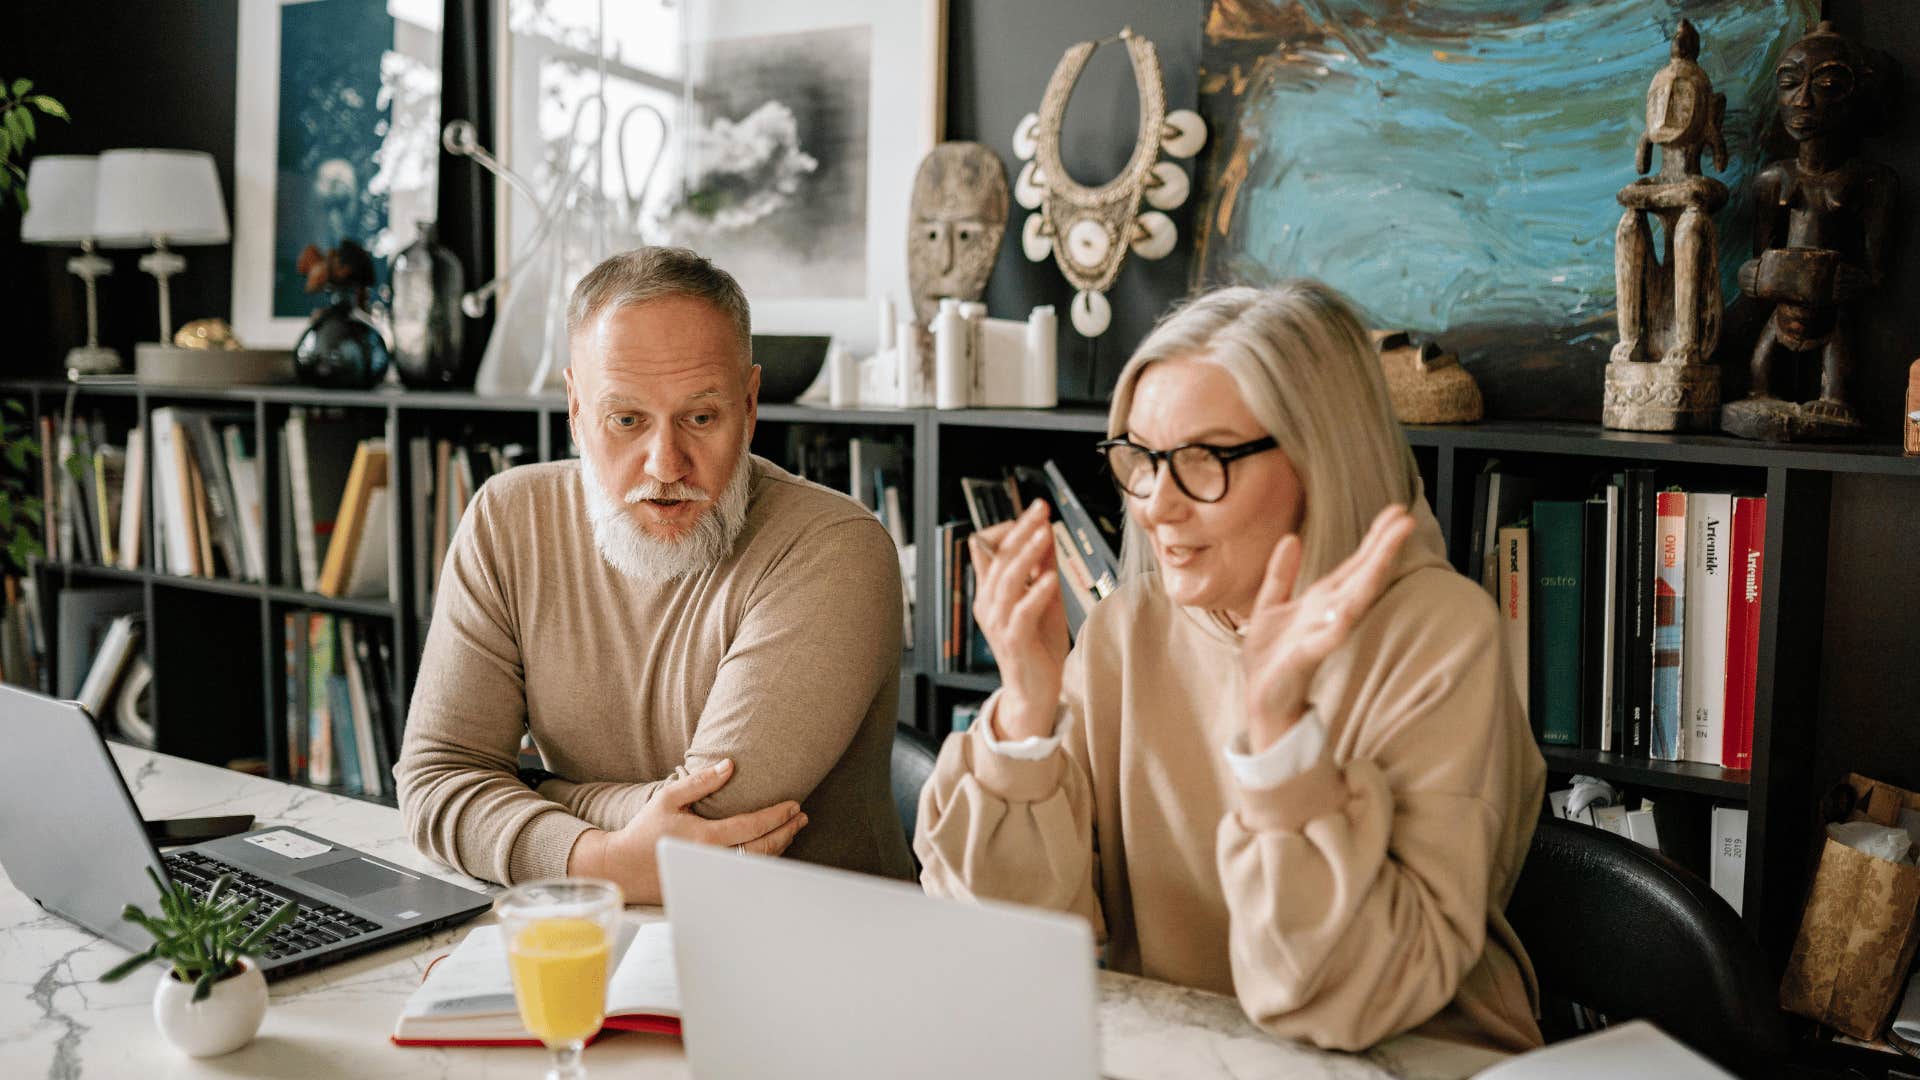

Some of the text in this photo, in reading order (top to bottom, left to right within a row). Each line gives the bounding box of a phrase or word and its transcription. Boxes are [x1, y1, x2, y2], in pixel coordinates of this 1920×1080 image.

[1706, 516, 1720, 575] Artemide
[1540, 576, 1576, 586] astro
[1745, 548, 1760, 604] Artemide
[1724, 837, 1732, 857] 2018
[1733, 838, 1742, 858] 2019
